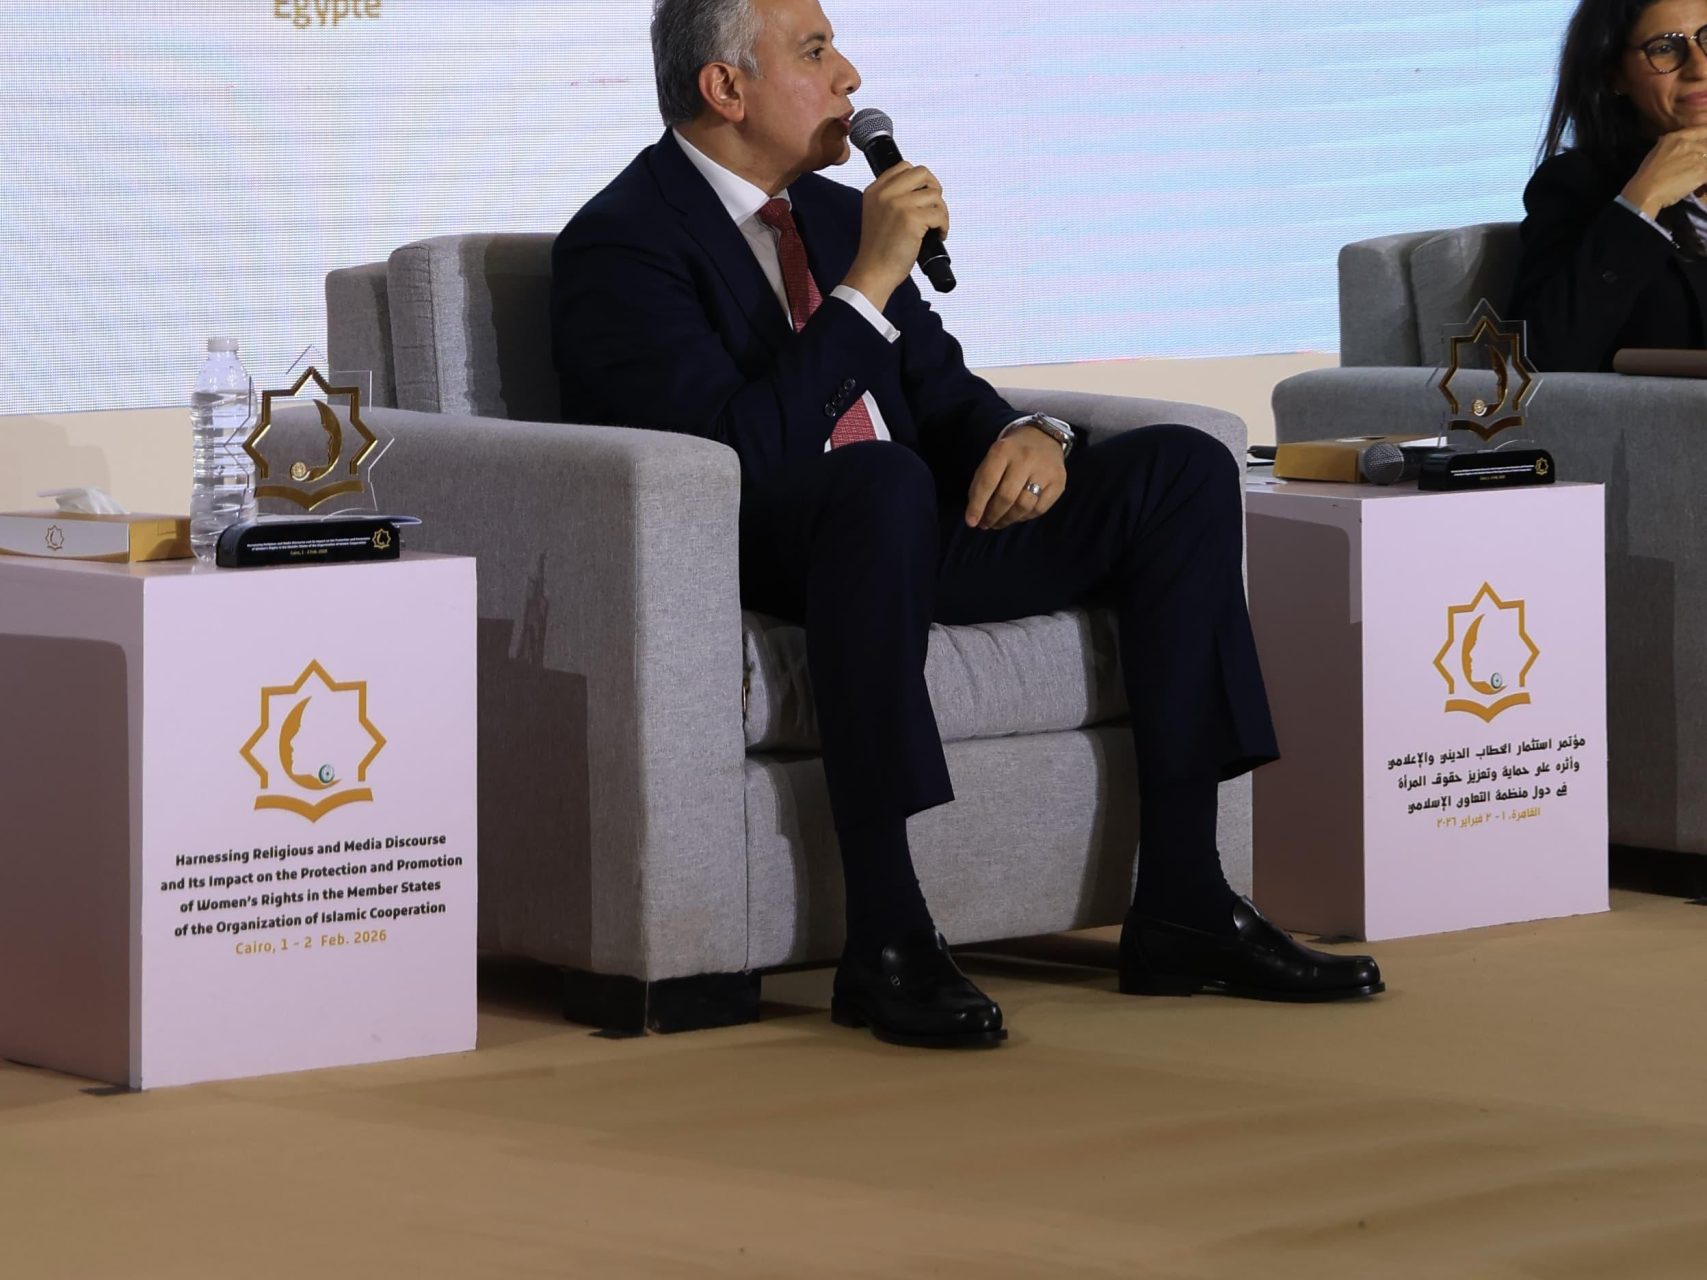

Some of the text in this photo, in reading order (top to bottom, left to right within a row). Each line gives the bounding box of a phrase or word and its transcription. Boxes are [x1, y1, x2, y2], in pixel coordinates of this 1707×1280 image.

[176, 834, 446, 866] Harnessing Religious and Media Discourse
[161, 855, 462, 891] and Its Impact on the Protection and Promotion
[180, 900, 194, 912] of
[262, 892, 303, 907] Rights
[307, 889, 319, 901] in
[323, 888, 344, 900] the
[347, 884, 398, 898] Member
[401, 881, 441, 893] States
[175, 902, 445, 936] of the Organization of Islamic Cooperation
[236, 941, 275, 954] Cairo,
[281, 939, 288, 950] 1
[304, 936, 312, 948] 2
[321, 933, 349, 946] Feb.
[354, 929, 387, 943] 2026
